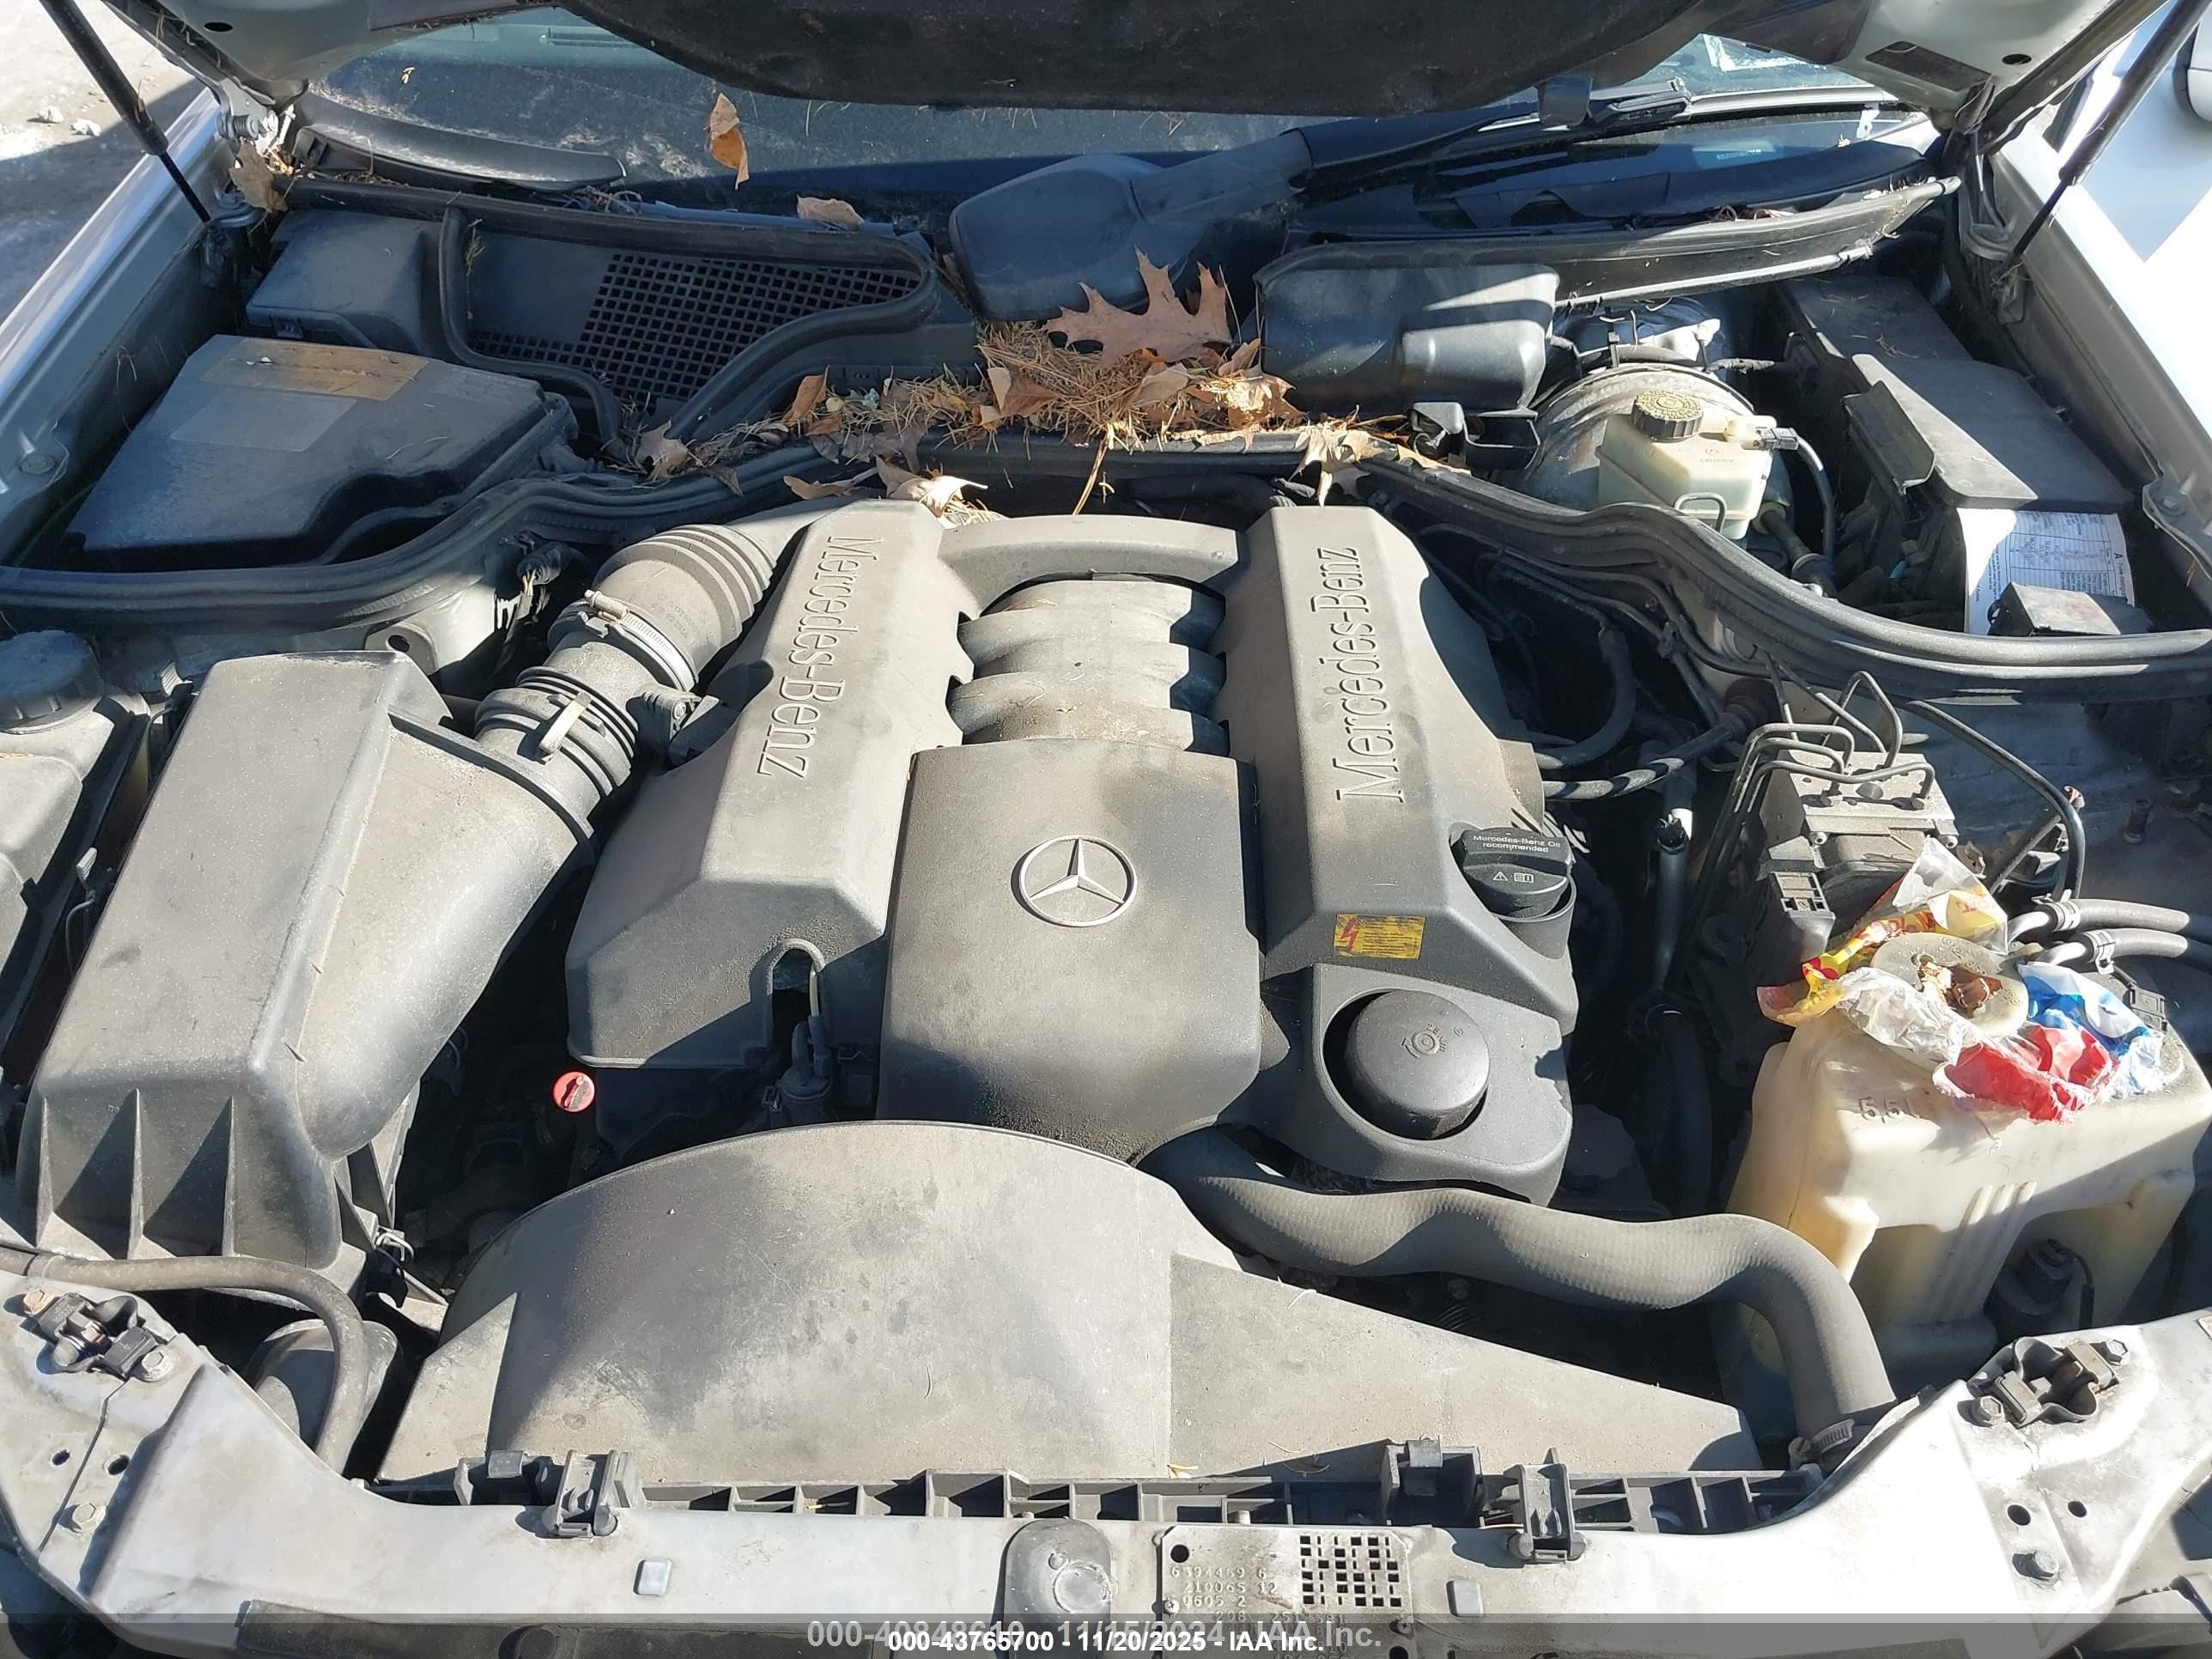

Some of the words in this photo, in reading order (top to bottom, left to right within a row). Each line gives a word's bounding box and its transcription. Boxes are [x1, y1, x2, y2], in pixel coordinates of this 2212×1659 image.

[756, 536, 883, 779] Mercedes-Benz
[1310, 546, 1404, 804] Mercedes-Benz
[1473, 835, 1547, 846] Mercedes-Benz
[1482, 842, 1549, 853] recommended
